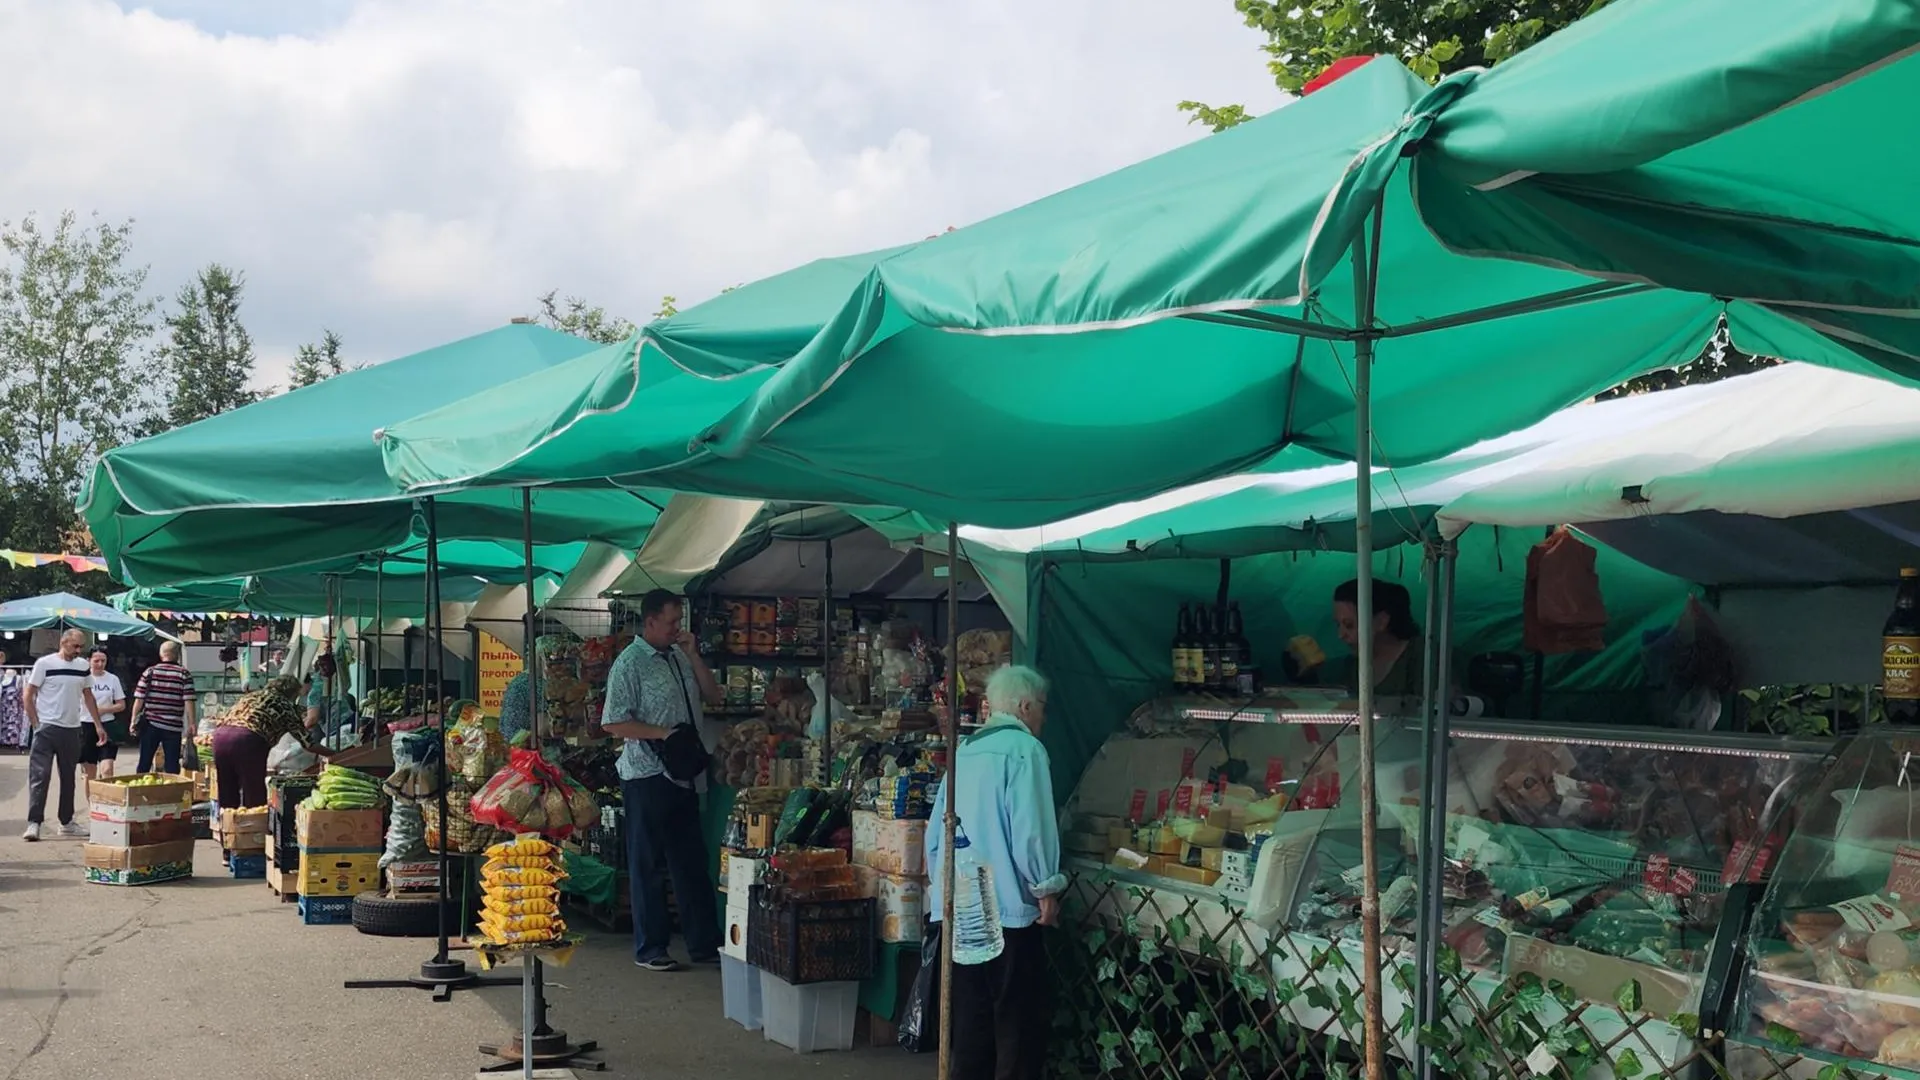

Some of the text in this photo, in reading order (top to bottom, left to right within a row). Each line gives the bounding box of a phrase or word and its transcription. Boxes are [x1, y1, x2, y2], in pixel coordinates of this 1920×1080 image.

[481, 652, 521, 660] ПЫЛЬ
[1886, 669, 1912, 678] КВАС
[484, 699, 502, 708] МО
